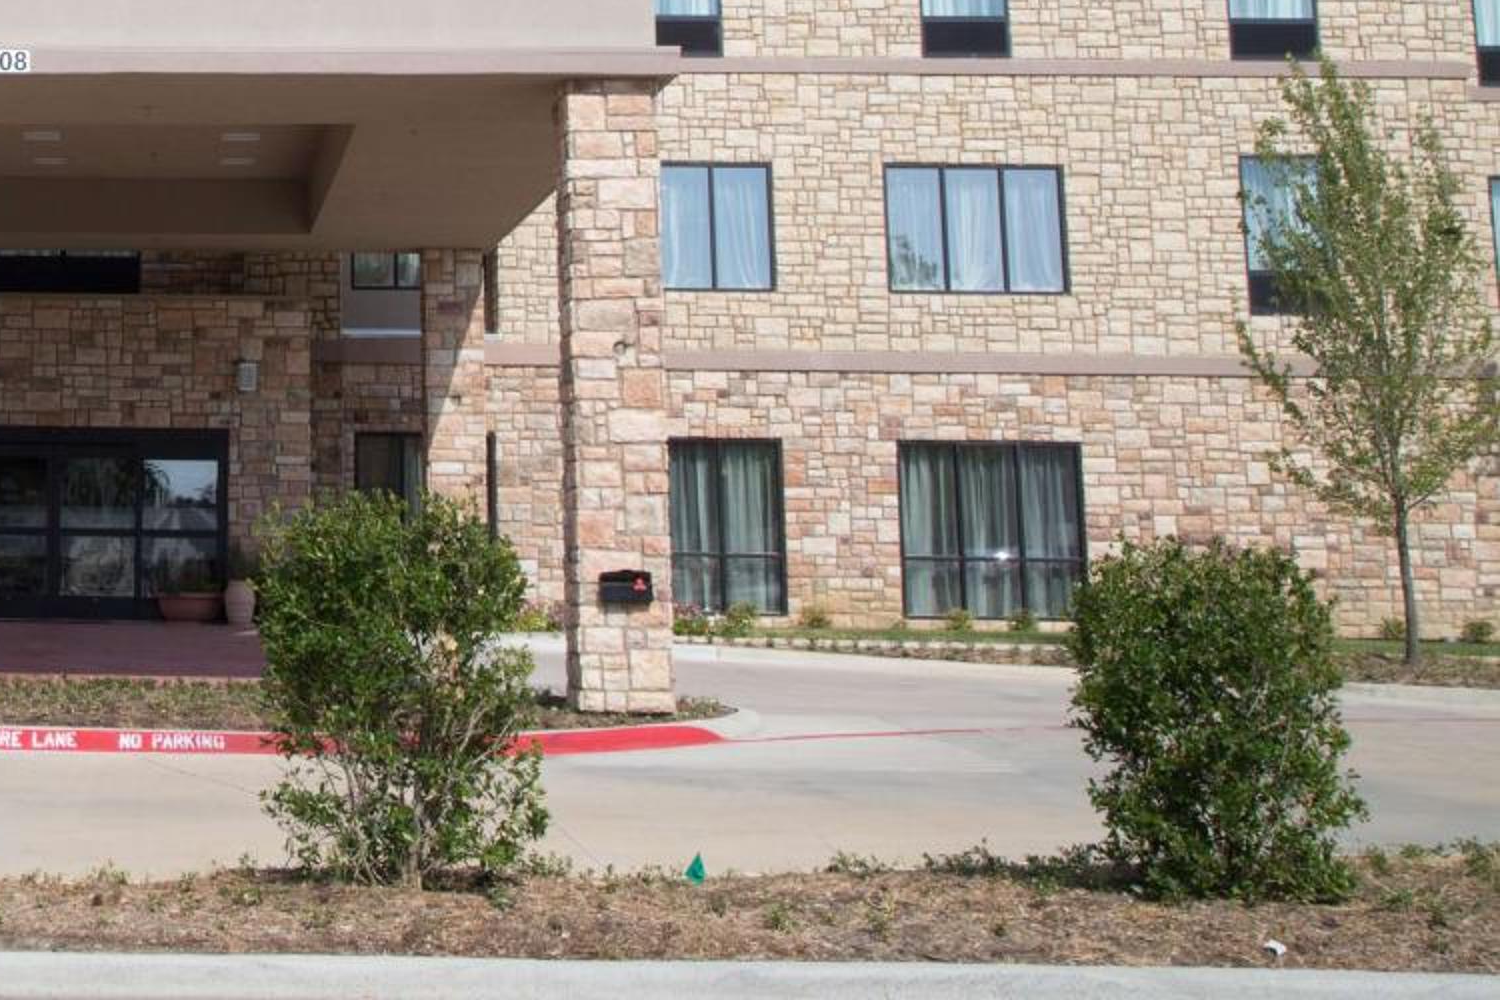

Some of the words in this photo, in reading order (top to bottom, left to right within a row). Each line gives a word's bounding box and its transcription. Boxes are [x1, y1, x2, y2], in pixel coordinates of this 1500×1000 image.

[31, 731, 79, 748] LANE
[118, 733, 142, 749] NO
[152, 733, 226, 749] PARKING
